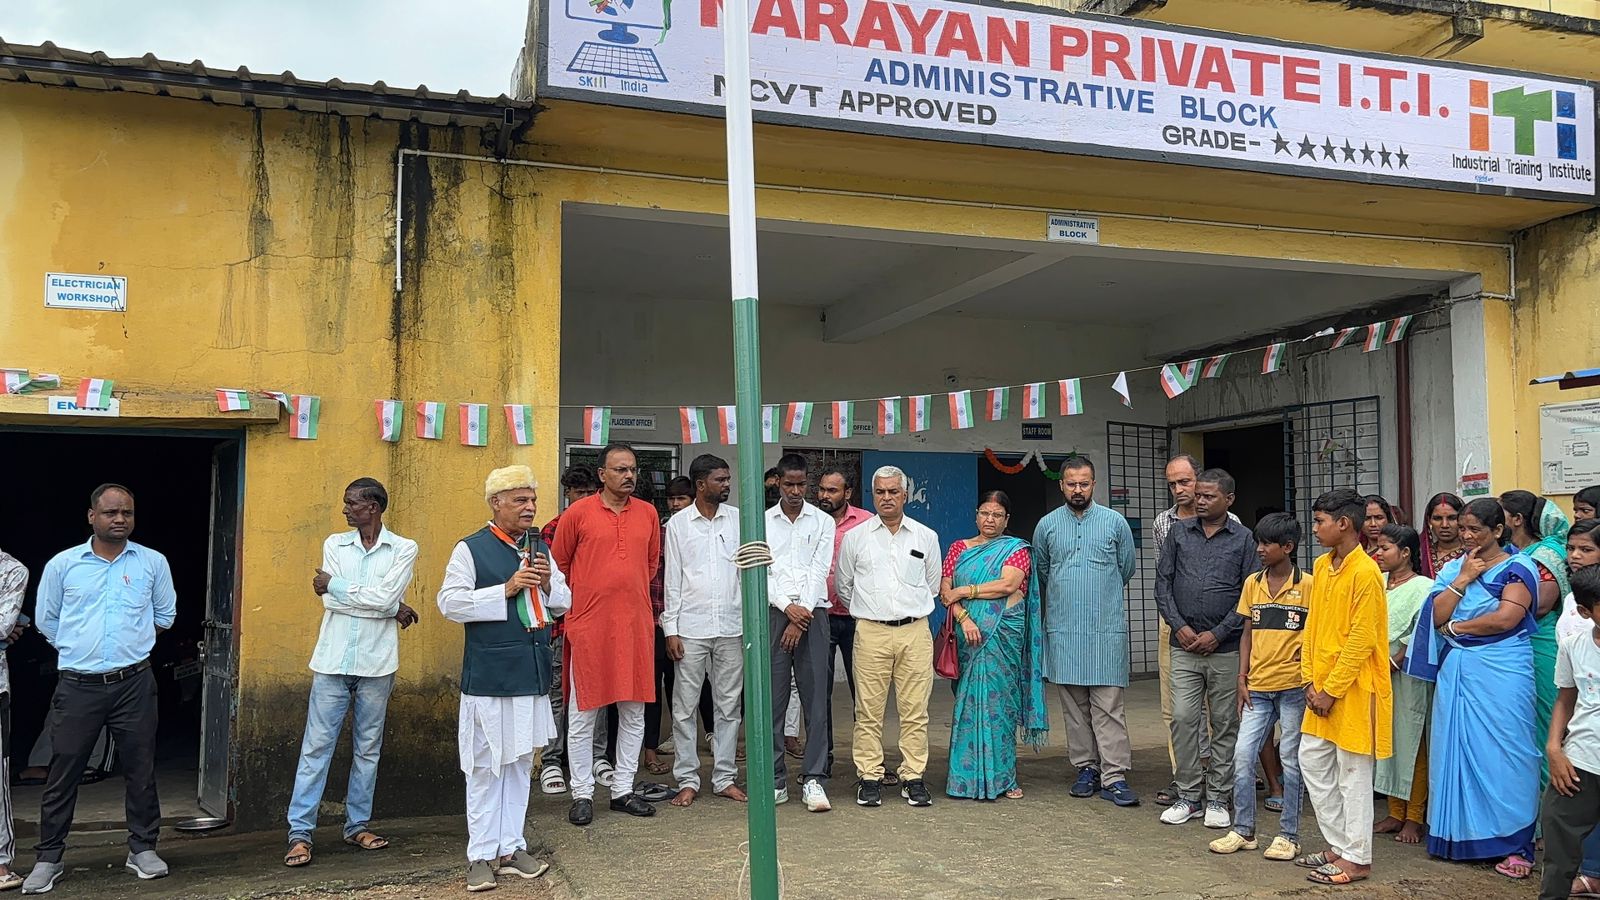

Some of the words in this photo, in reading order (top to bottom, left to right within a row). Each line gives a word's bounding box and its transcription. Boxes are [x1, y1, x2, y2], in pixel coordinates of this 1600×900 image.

[1050, 25, 1321, 104] PRIVATE
[1339, 63, 1449, 118] I.T.I.
[621, 80, 648, 93] India
[864, 57, 1155, 114] ADMINISTRATIVE
[1180, 95, 1278, 128] BLOCK
[839, 90, 997, 125] APPROVED
[1452, 154, 1500, 172] Industrial
[1506, 158, 1543, 181] Training
[1548, 162, 1592, 181] Institute
[1050, 218, 1096, 230] ADMINISTRATIVE
[1059, 230, 1088, 239] BLOCK
[51, 278, 121, 290] ELECTRICIAN
[57, 292, 118, 303] WORKSHOP
